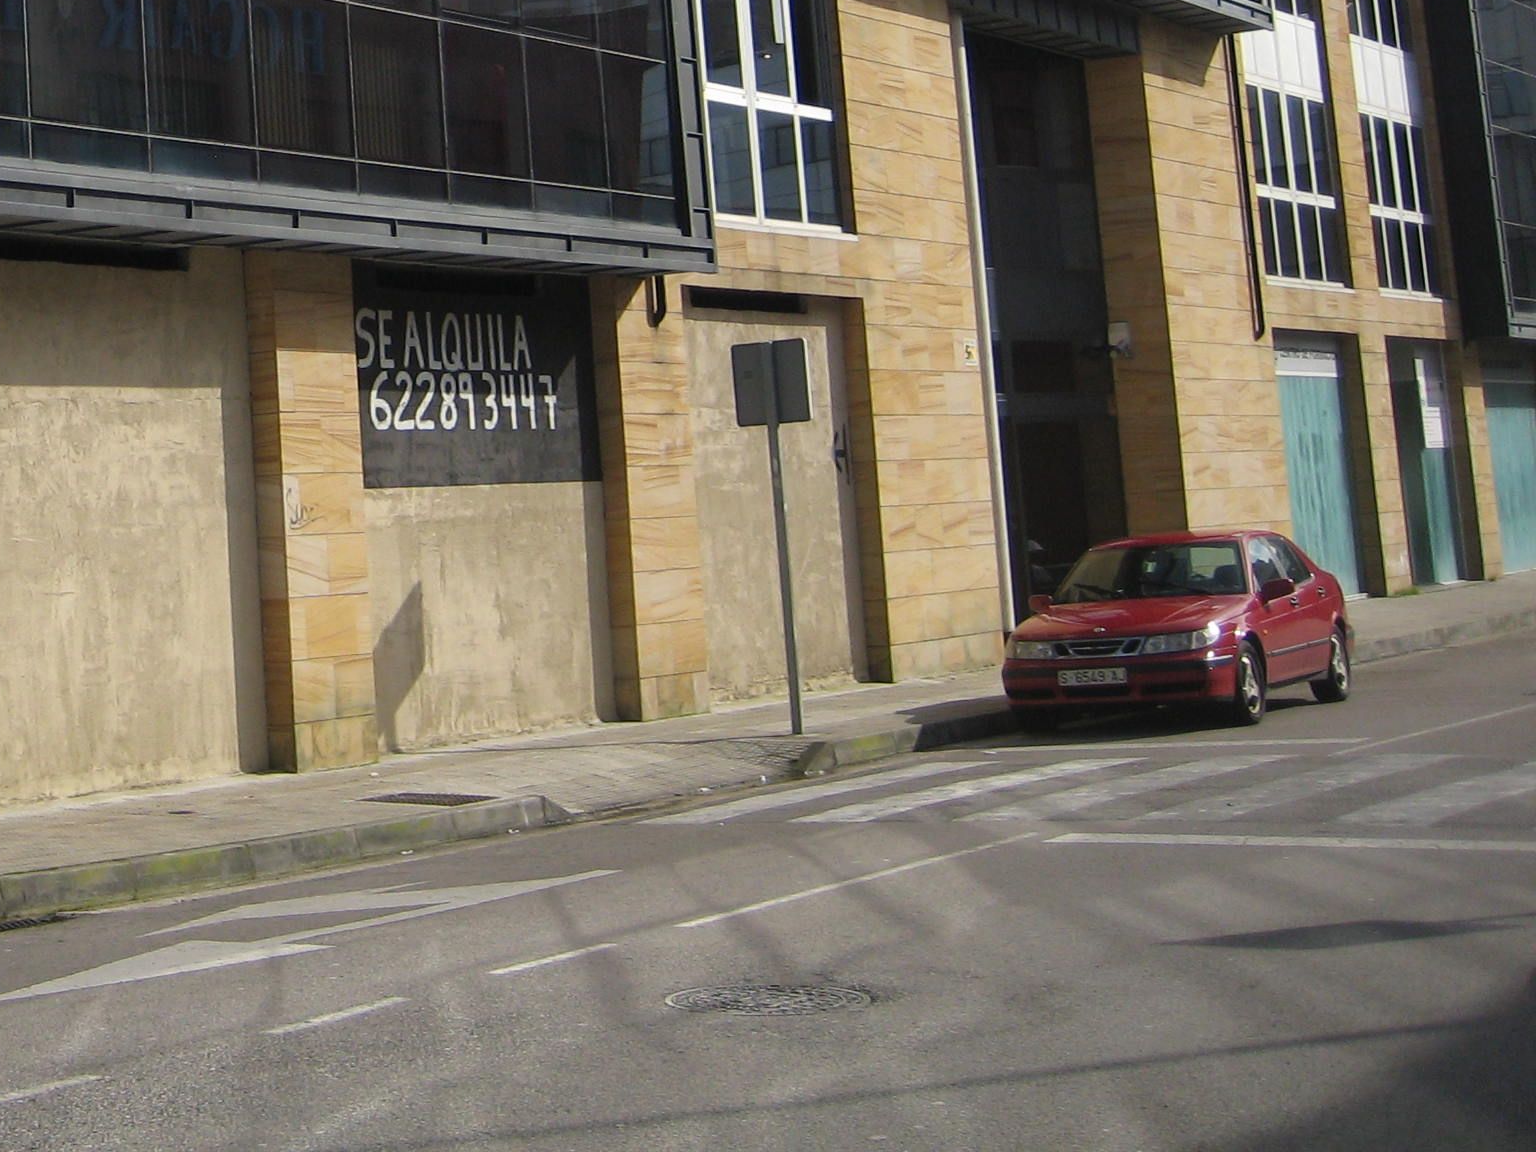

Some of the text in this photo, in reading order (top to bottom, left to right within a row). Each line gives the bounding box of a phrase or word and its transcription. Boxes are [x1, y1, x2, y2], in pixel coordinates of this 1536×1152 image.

[355, 307, 532, 372] SE ALQUILA
[370, 370, 558, 431] 622893447
